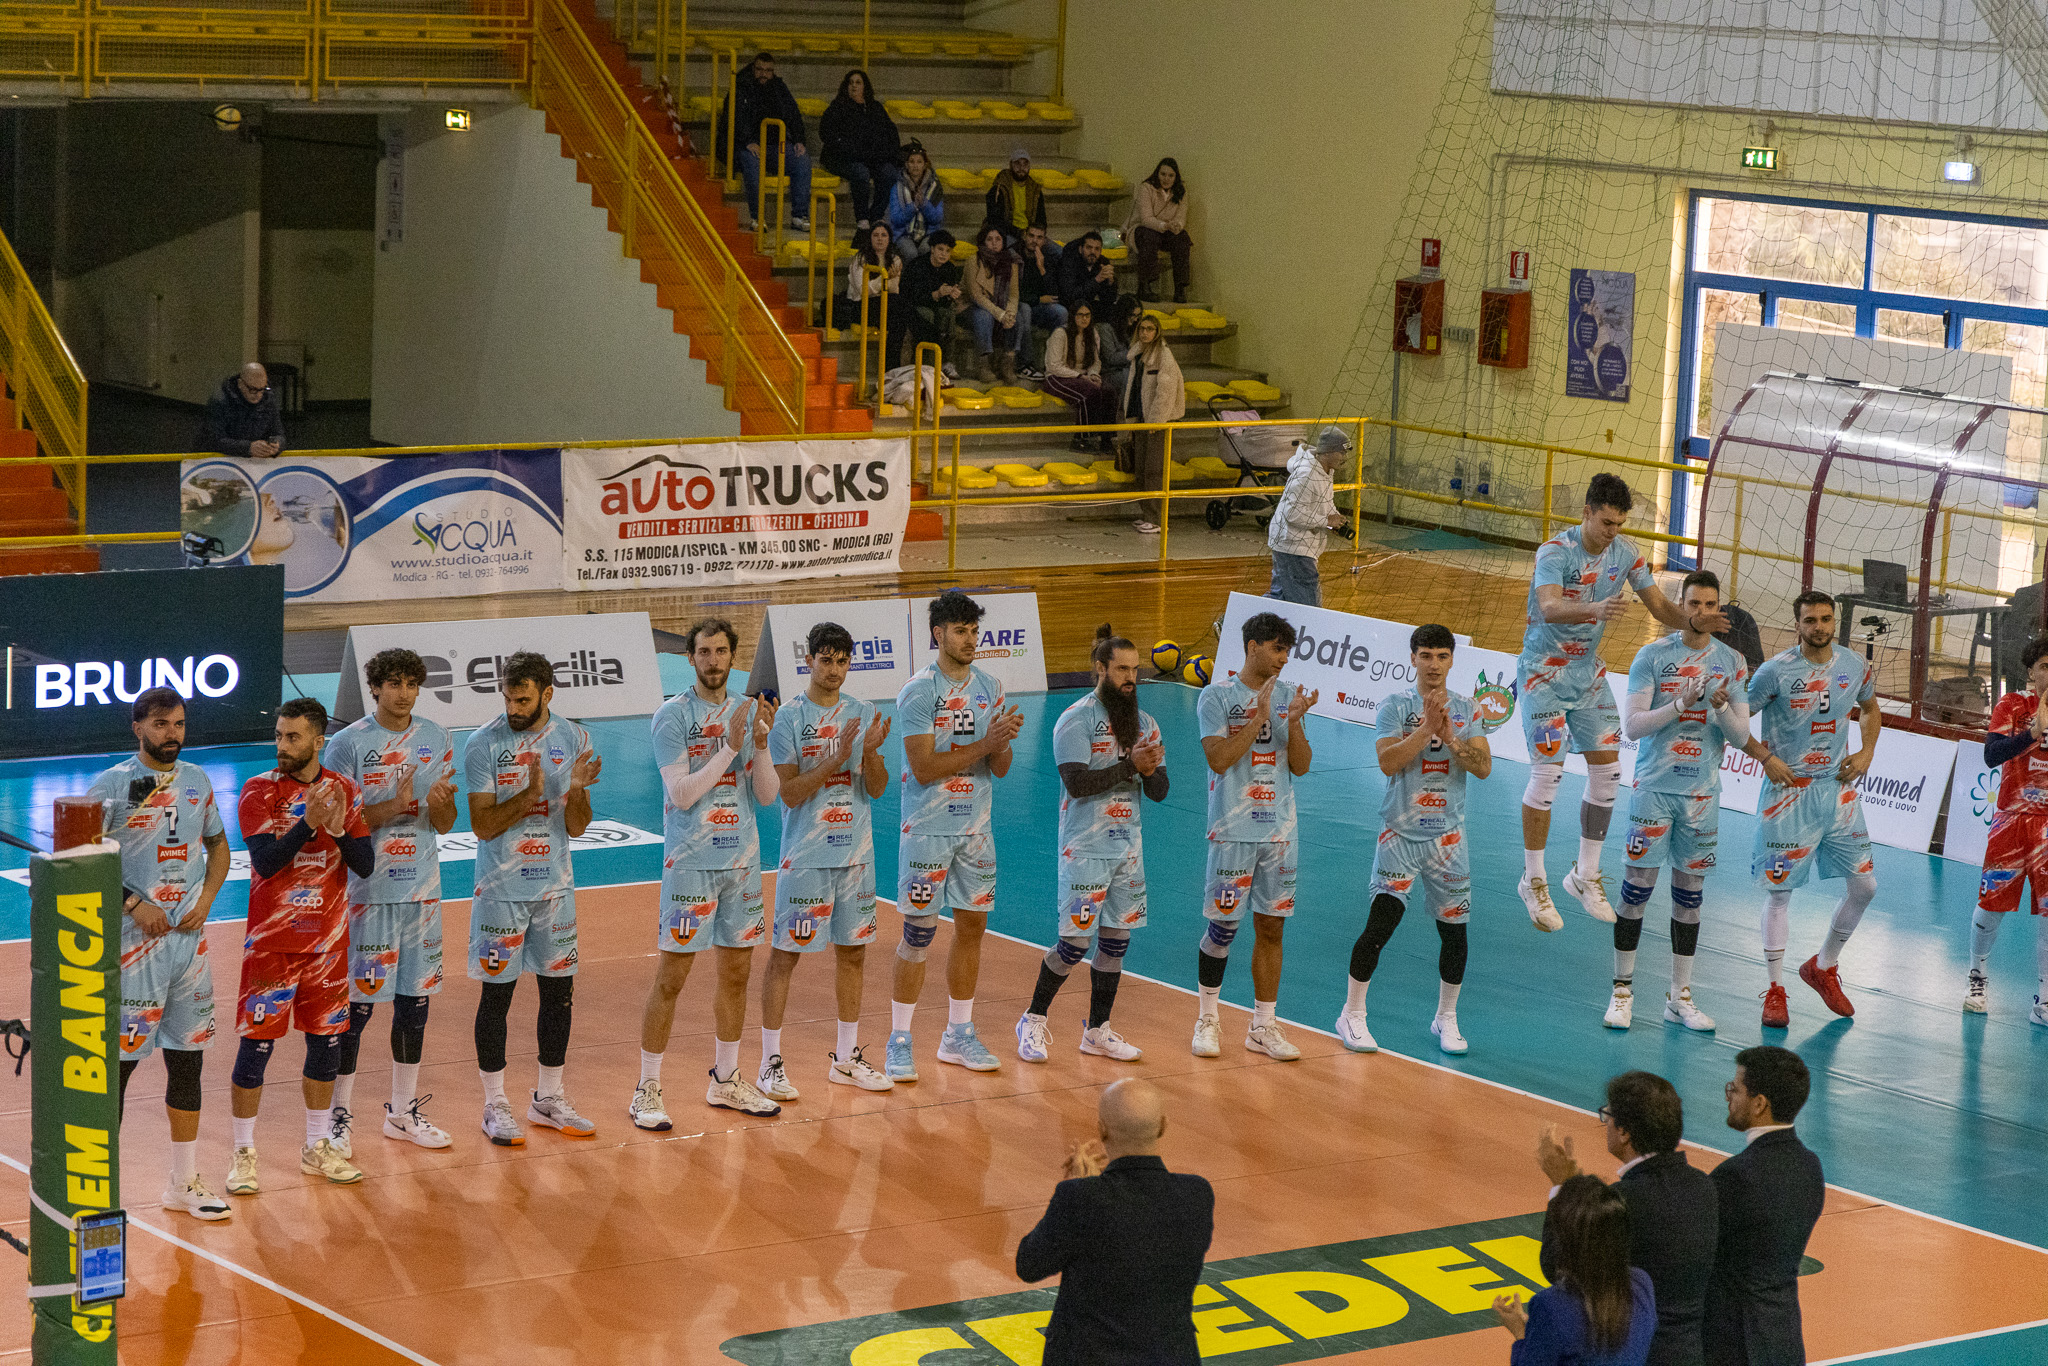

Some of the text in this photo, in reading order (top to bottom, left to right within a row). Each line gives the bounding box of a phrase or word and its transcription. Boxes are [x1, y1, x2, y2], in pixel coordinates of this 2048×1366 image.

[601, 460, 889, 515] auto TRUCKS
[436, 507, 513, 523] STUDIO
[627, 522, 668, 538] VENDITA
[678, 518, 722, 534] SERVIZI
[733, 515, 803, 532] CARROZZERIA
[814, 511, 860, 528] OFFICINA
[585, 549, 608, 562] S.S.
[613, 547, 633, 562] 115
[636, 543, 728, 560] MODICA/ISPICA
[739, 541, 758, 555] KM
[799, 538, 820, 552] SNC
[833, 535, 870, 549] MODICA
[872, 532, 893, 548] (RG)
[391, 550, 533, 568] www.studioacqua.it
[393, 572, 427, 582] Modica
[436, 571, 449, 580] RG
[459, 569, 473, 579] tel.
[577, 565, 618, 580] Tel./Fax
[622, 563, 694, 579] 0932.906719
[974, 649, 1009, 659] ubblicità
[1289, 625, 1417, 683] bate grou
[36, 654, 239, 709] BRUNO
[1819, 690, 1831, 714] 5
[953, 708, 975, 735] 22
[1677, 746, 1702, 758] coop
[1808, 756, 1831, 766] coop
[950, 783, 974, 794] coop
[1253, 790, 1276, 802] coop
[1855, 774, 1926, 803] Avimed
[1421, 798, 1447, 809] coop
[1865, 795, 1886, 806] UOVO
[1895, 802, 1917, 813] UOVO
[164, 806, 178, 836] 7
[713, 814, 739, 826] coop
[828, 812, 853, 824] coop
[1111, 808, 1132, 819] coop
[160, 849, 186, 857] AVIMEC
[390, 844, 417, 857] coop
[523, 844, 550, 857] coop
[1628, 835, 1644, 855] 15
[297, 855, 324, 863] AVIMEC
[910, 861, 943, 870] LEOCATA
[1217, 868, 1247, 876] LEOCATA
[1773, 861, 1784, 879] 5
[911, 882, 932, 904] 22
[1072, 883, 1103, 891] LEOCATA
[293, 896, 324, 909] coop
[672, 894, 707, 903] LEOCATA
[790, 897, 824, 905] LEOCATA
[1220, 889, 1236, 909] 13
[1080, 903, 1090, 924] 6
[481, 924, 517, 934] LEOCATA
[679, 917, 691, 939] 11
[795, 919, 812, 940] 10
[356, 944, 391, 952] LEOCATA
[488, 948, 499, 970] 2
[364, 967, 376, 989] 4
[56, 891, 108, 1094] BANCA
[253, 1003, 266, 1025] 8
[127, 1023, 139, 1046] 7
